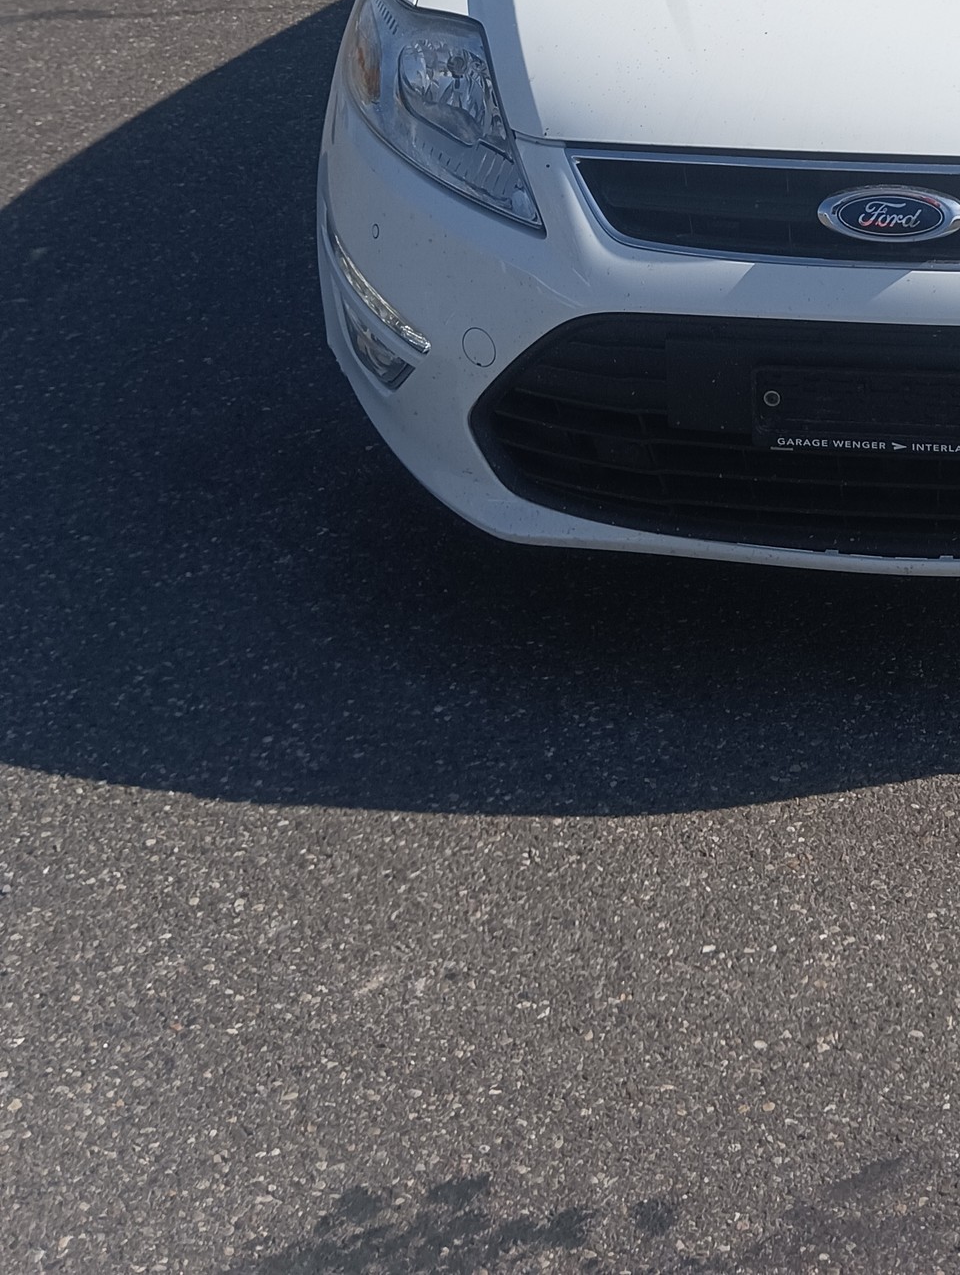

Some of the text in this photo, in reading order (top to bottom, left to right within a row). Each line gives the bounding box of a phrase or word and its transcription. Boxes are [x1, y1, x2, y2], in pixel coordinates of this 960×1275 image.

[858, 201, 922, 228] Ford
[777, 437, 829, 448] GARAGE
[833, 439, 887, 450] WENGER
